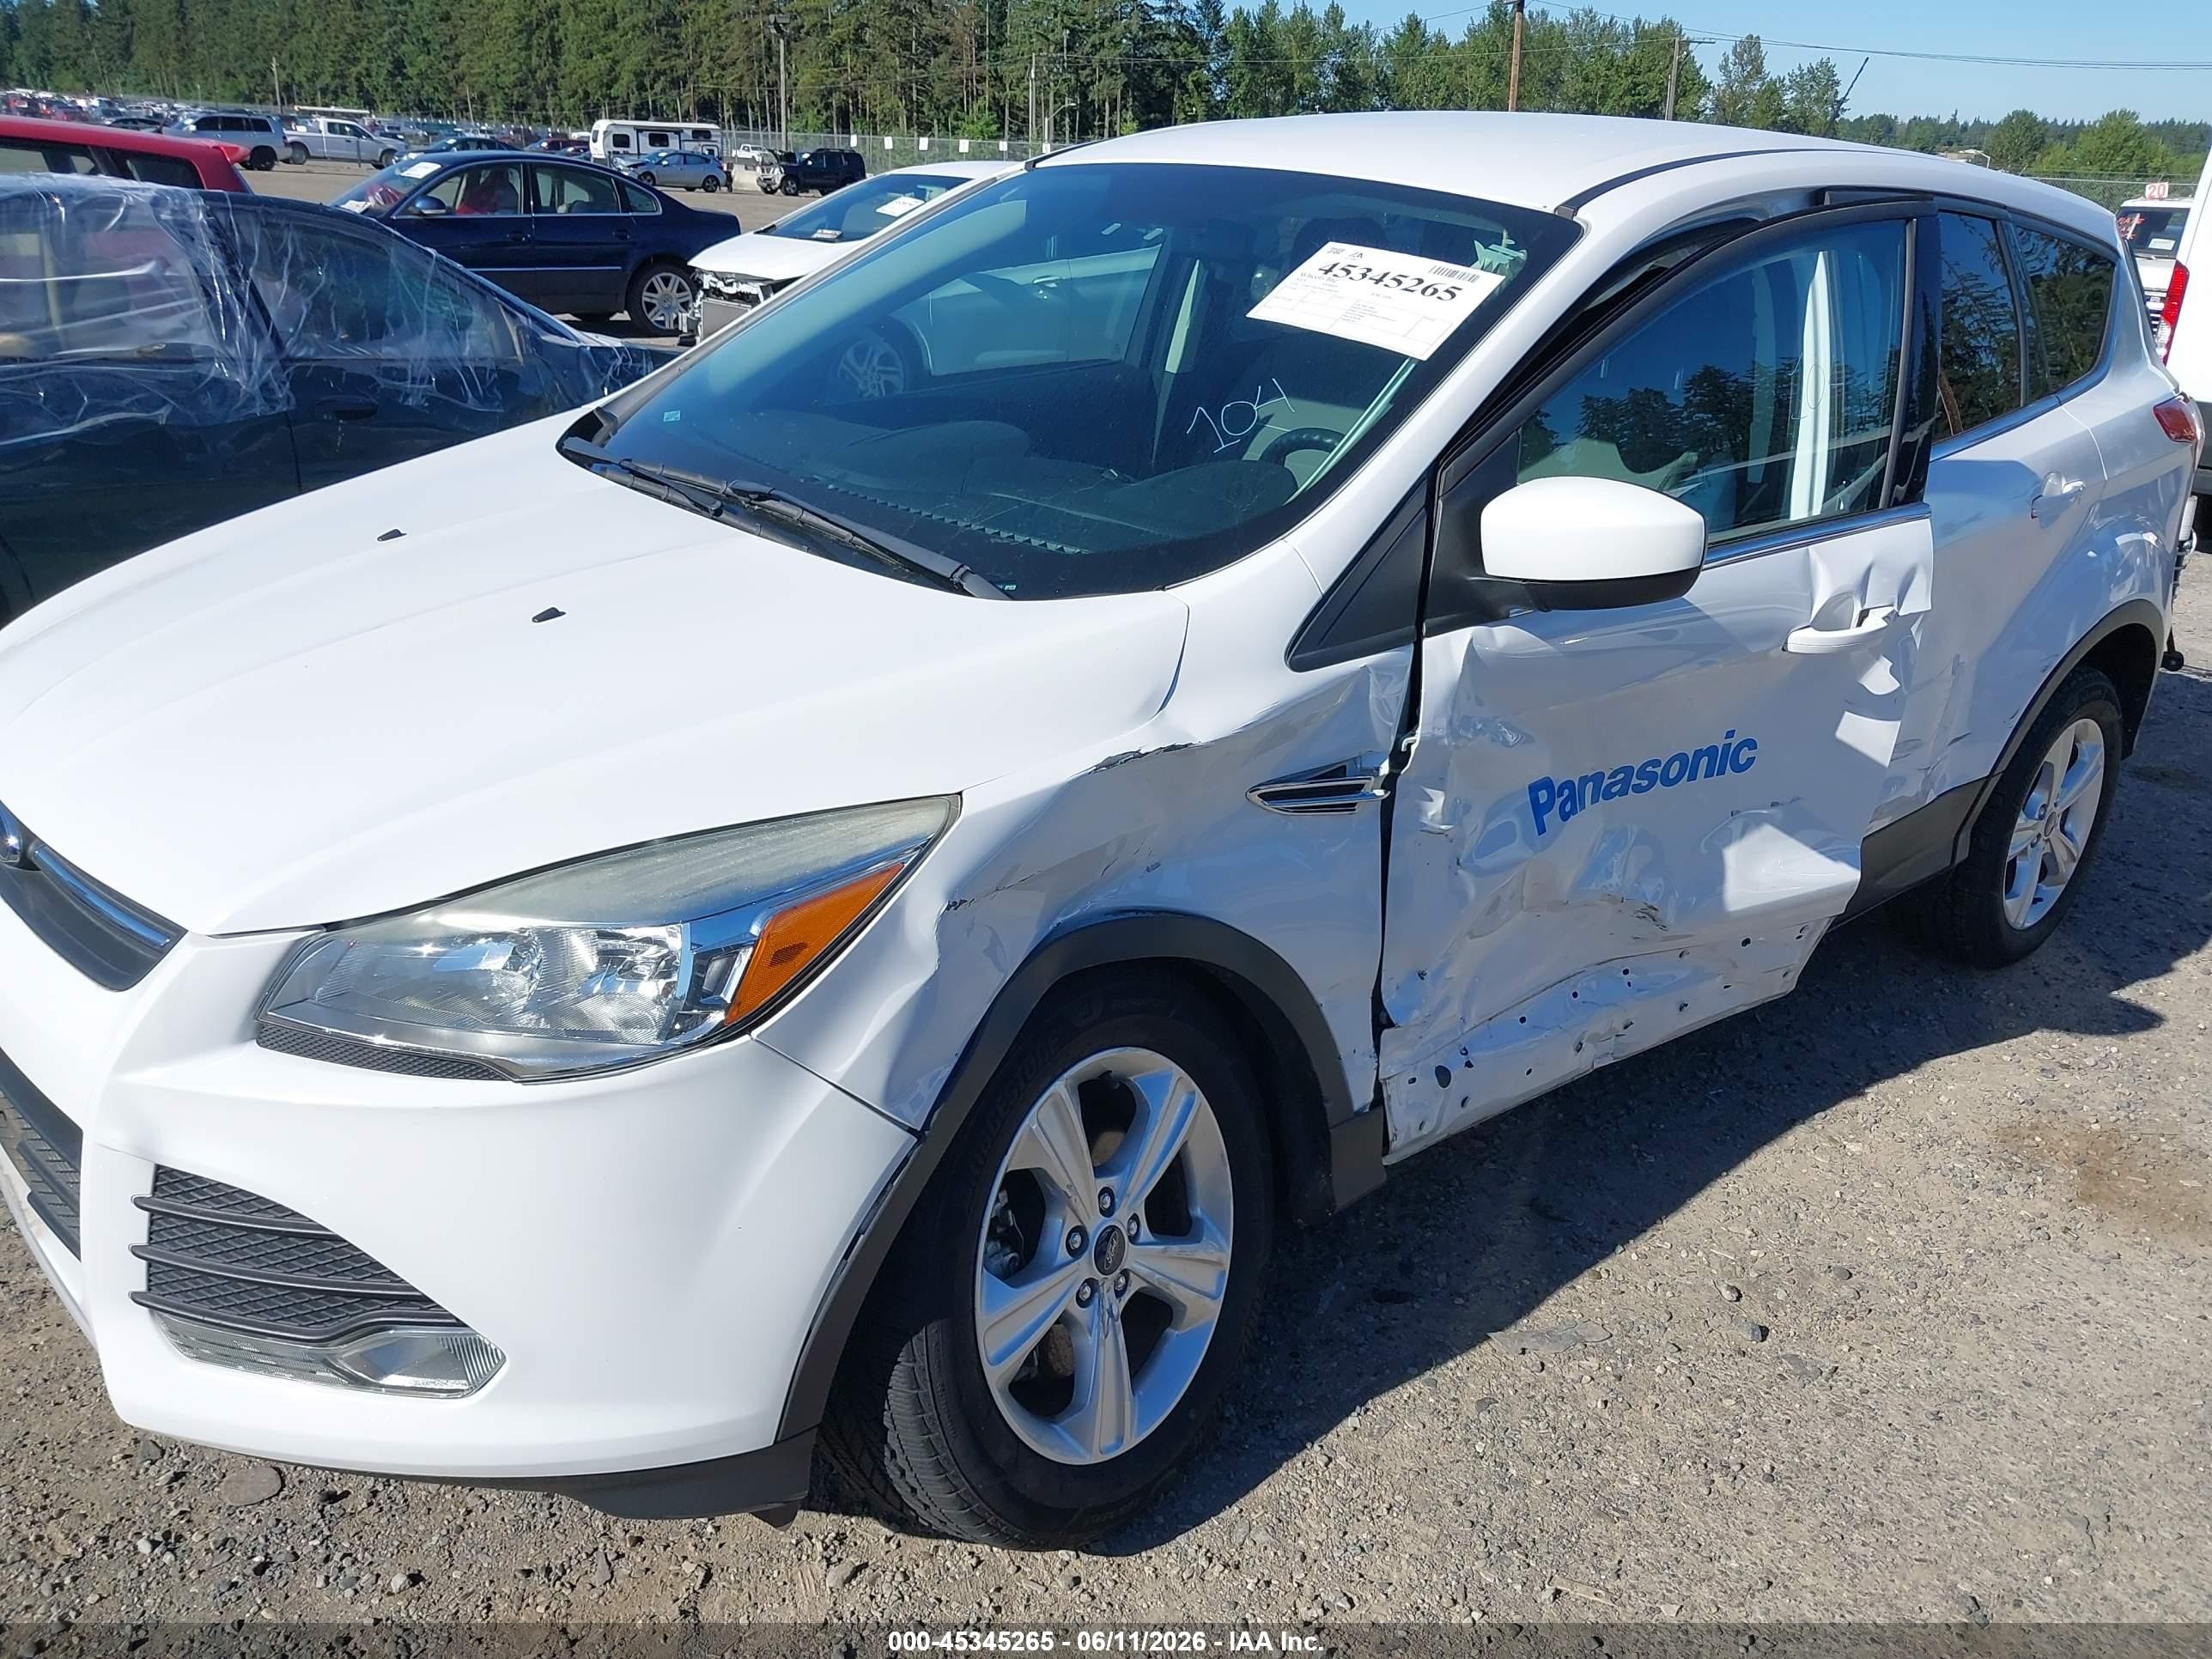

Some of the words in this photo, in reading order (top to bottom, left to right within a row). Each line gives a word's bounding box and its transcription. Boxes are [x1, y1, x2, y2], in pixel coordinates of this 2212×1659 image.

[2148, 184, 2166, 198] 20
[1318, 262, 1463, 301] 45345265
[1528, 729, 1759, 836] Panasonic
